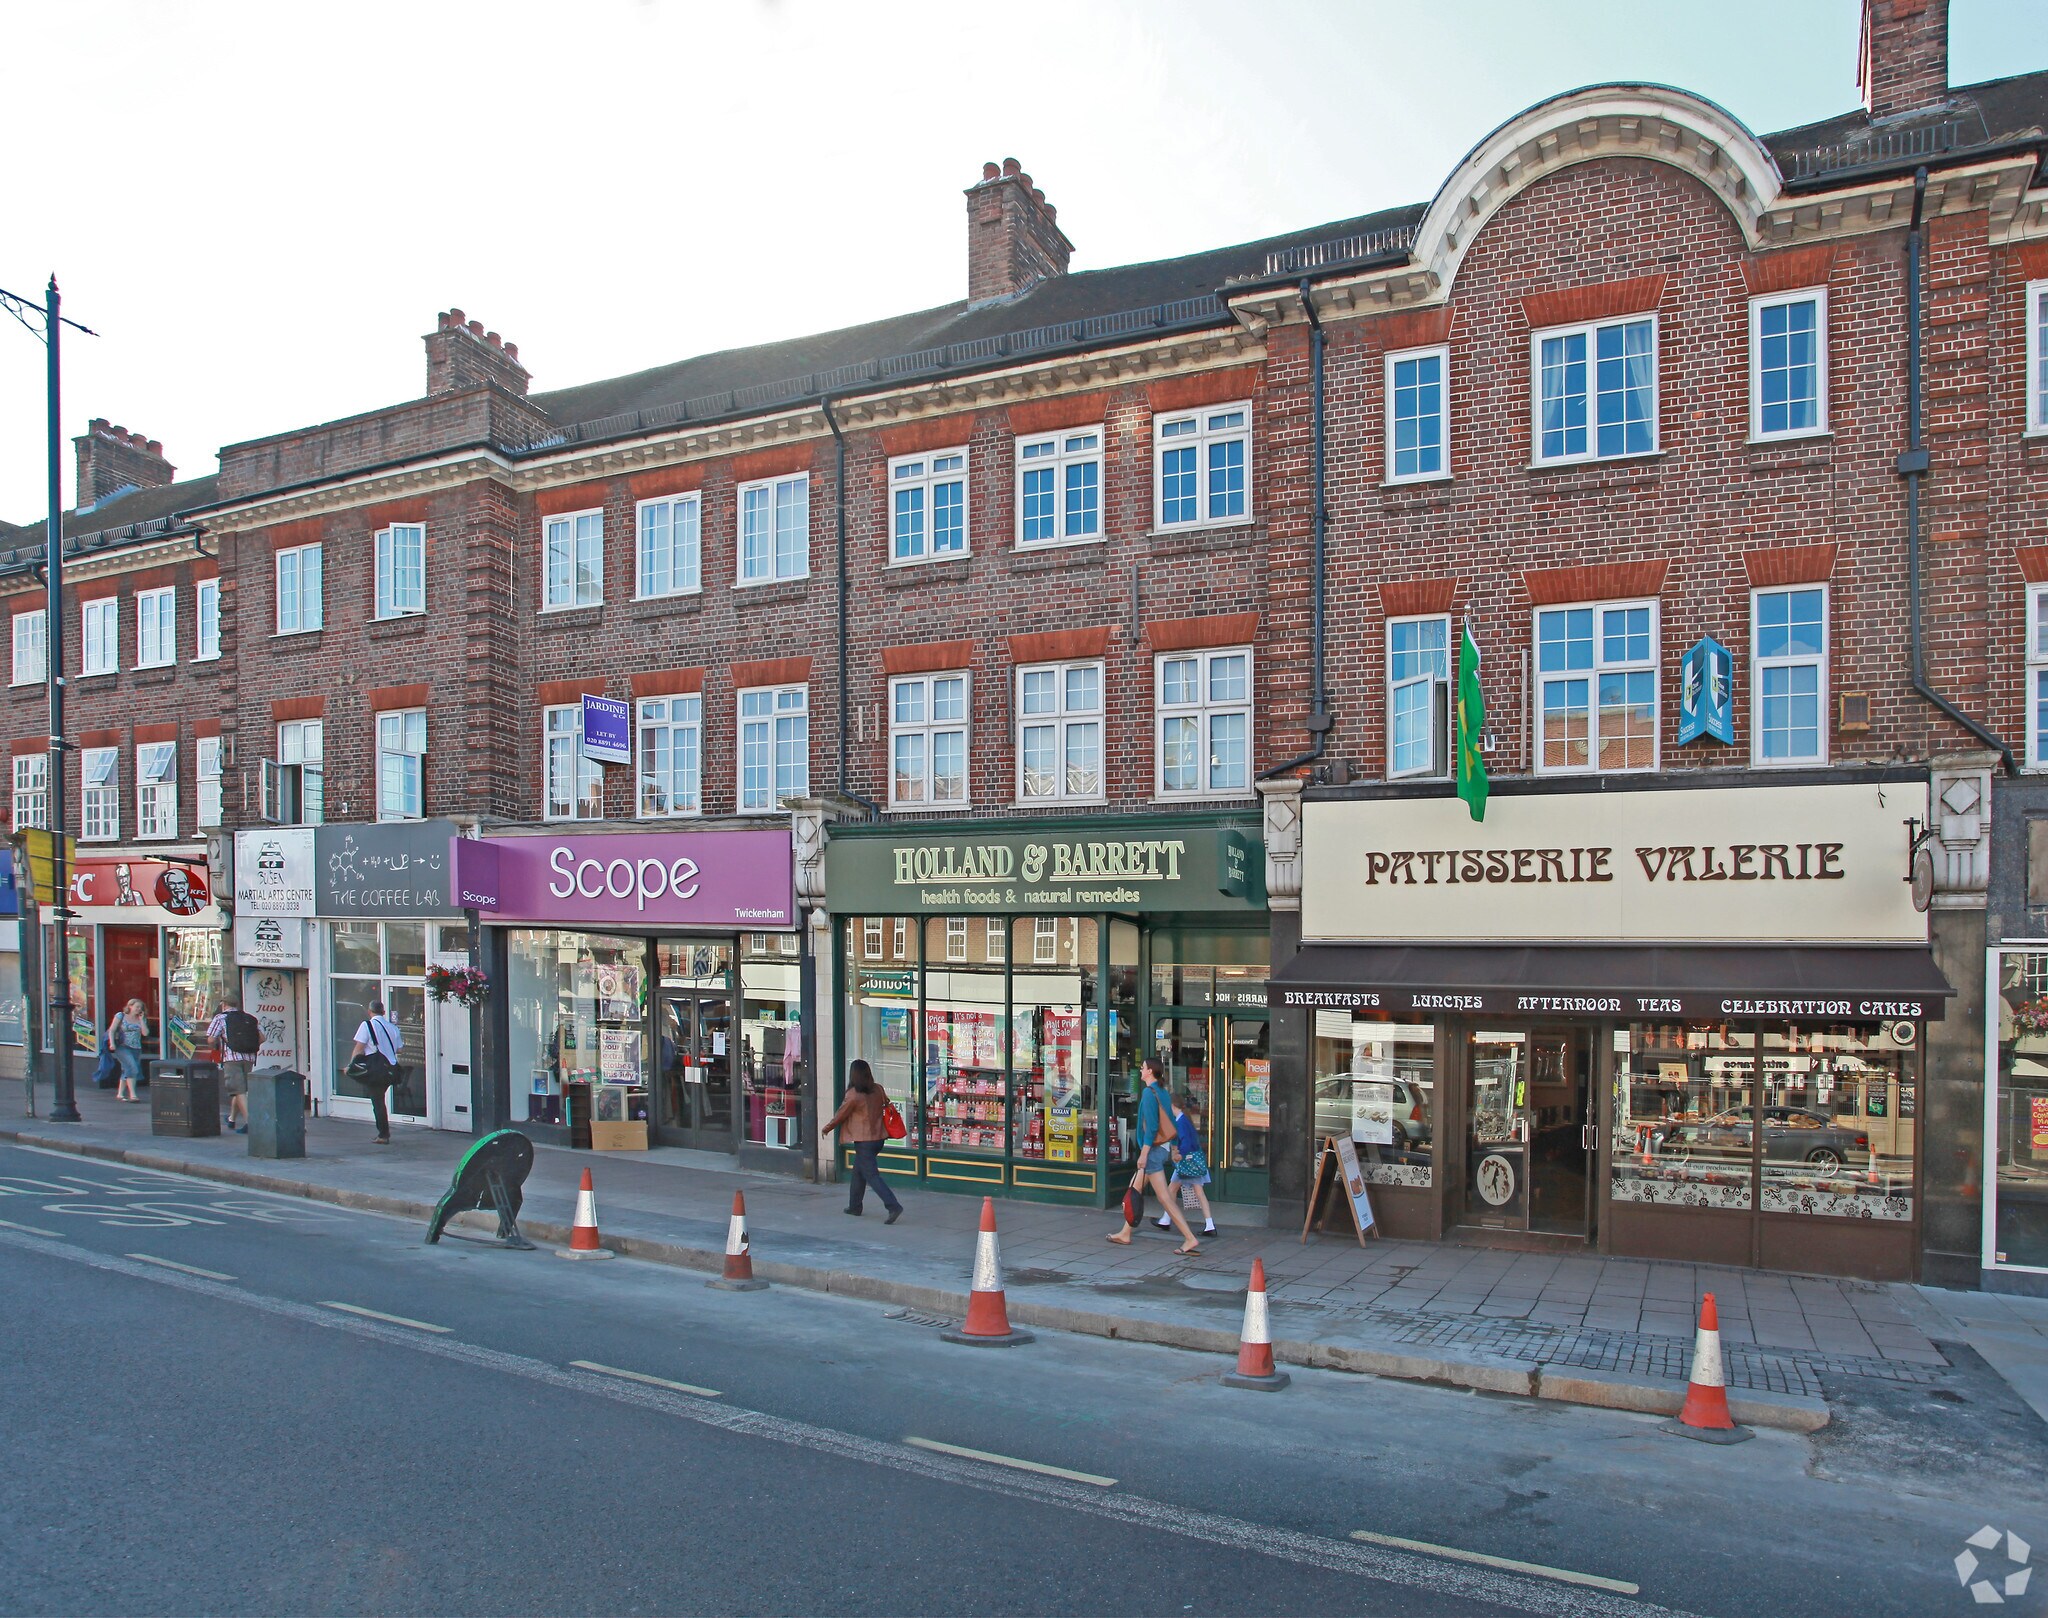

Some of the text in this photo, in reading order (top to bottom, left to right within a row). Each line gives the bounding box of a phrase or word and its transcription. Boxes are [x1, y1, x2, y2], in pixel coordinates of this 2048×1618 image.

[586, 700, 625, 714] JARDINE
[893, 840, 1185, 884] HOLLAND & BARRETT
[1365, 842, 1845, 886] PATISSERIE VALERIE
[549, 847, 700, 911] Scope
[238, 889, 312, 901] MARTIAL ARTS CENTRE
[330, 889, 440, 906] THE COFFEE LAB
[462, 890, 496, 905] Scope
[921, 886, 1140, 905] health foods & natural remedies
[734, 908, 784, 919] Twickenham
[256, 1004, 285, 1013] JUDO
[1284, 992, 1922, 1016] BREAKFASTS LUNCHES AFTERNOON TEAS CELEBRATION CAKES
[929, 1015, 945, 1023] Price
[1046, 1020, 1060, 1029] Half
[1056, 1028, 1071, 1037] Sale
[258, 1049, 291, 1057] ARATE
